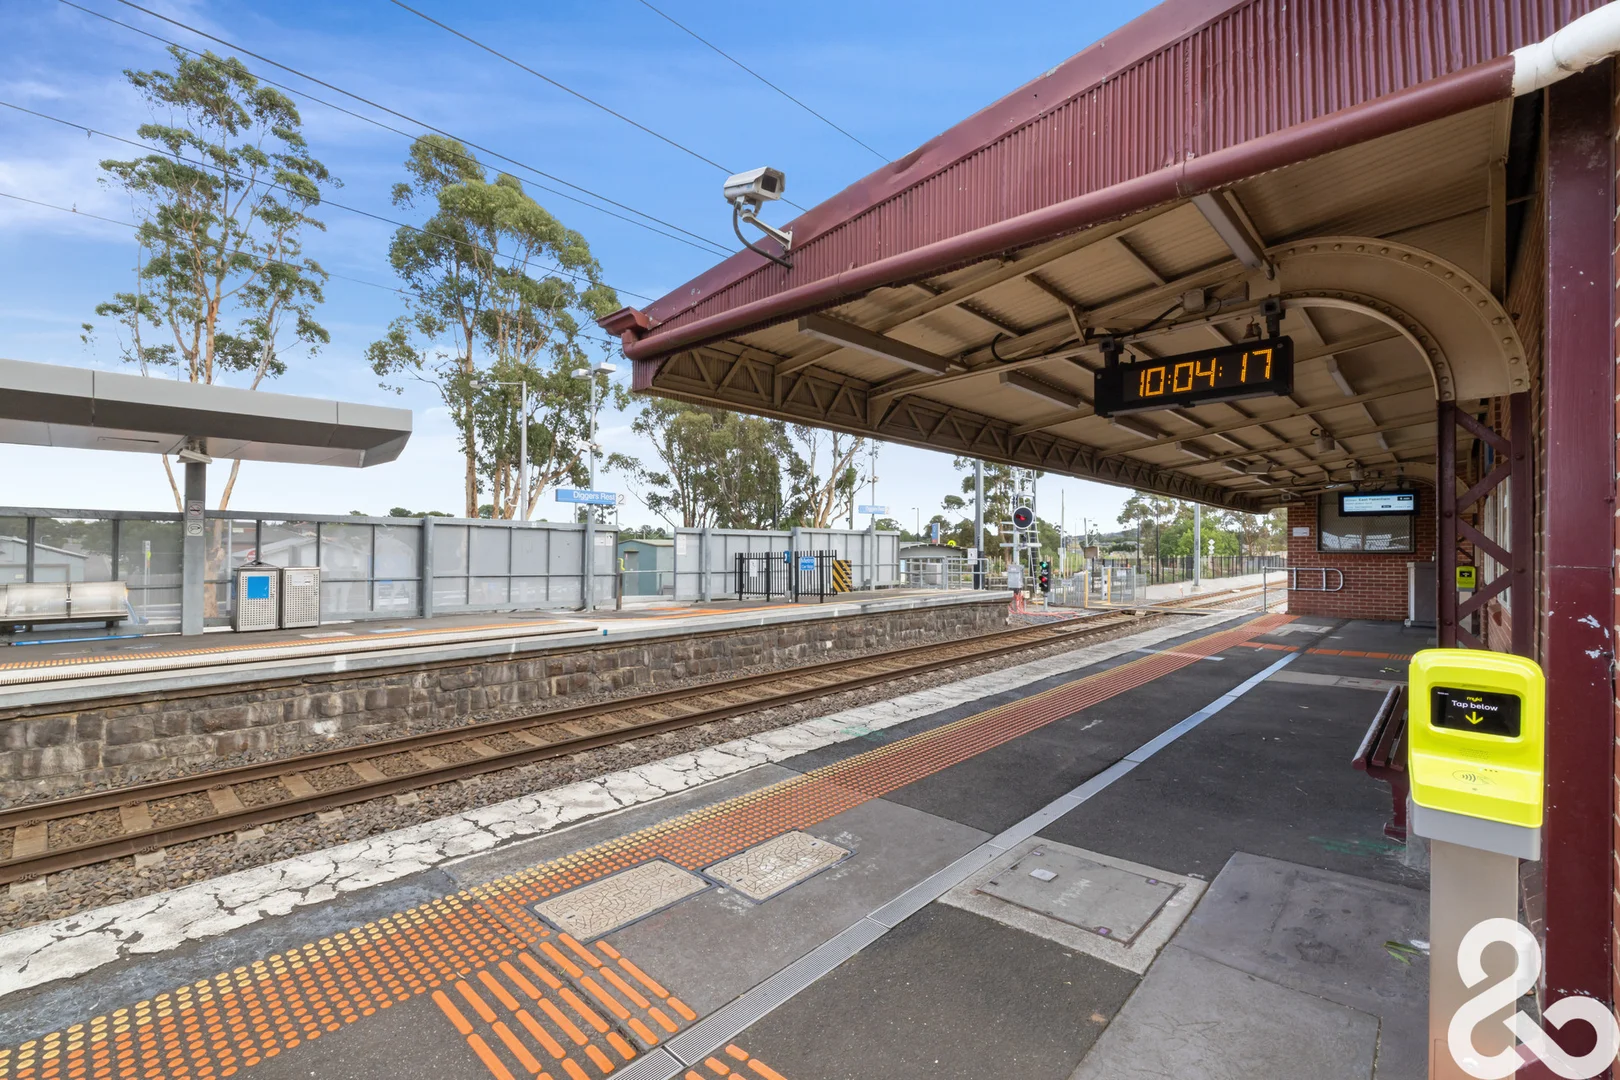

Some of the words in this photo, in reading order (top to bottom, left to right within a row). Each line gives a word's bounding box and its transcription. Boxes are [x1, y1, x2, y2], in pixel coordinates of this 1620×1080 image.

[573, 491, 599, 500] Diggers
[618, 494, 624, 504] 2
[1451, 700, 1468, 708] Tap
[1470, 702, 1498, 711] below
